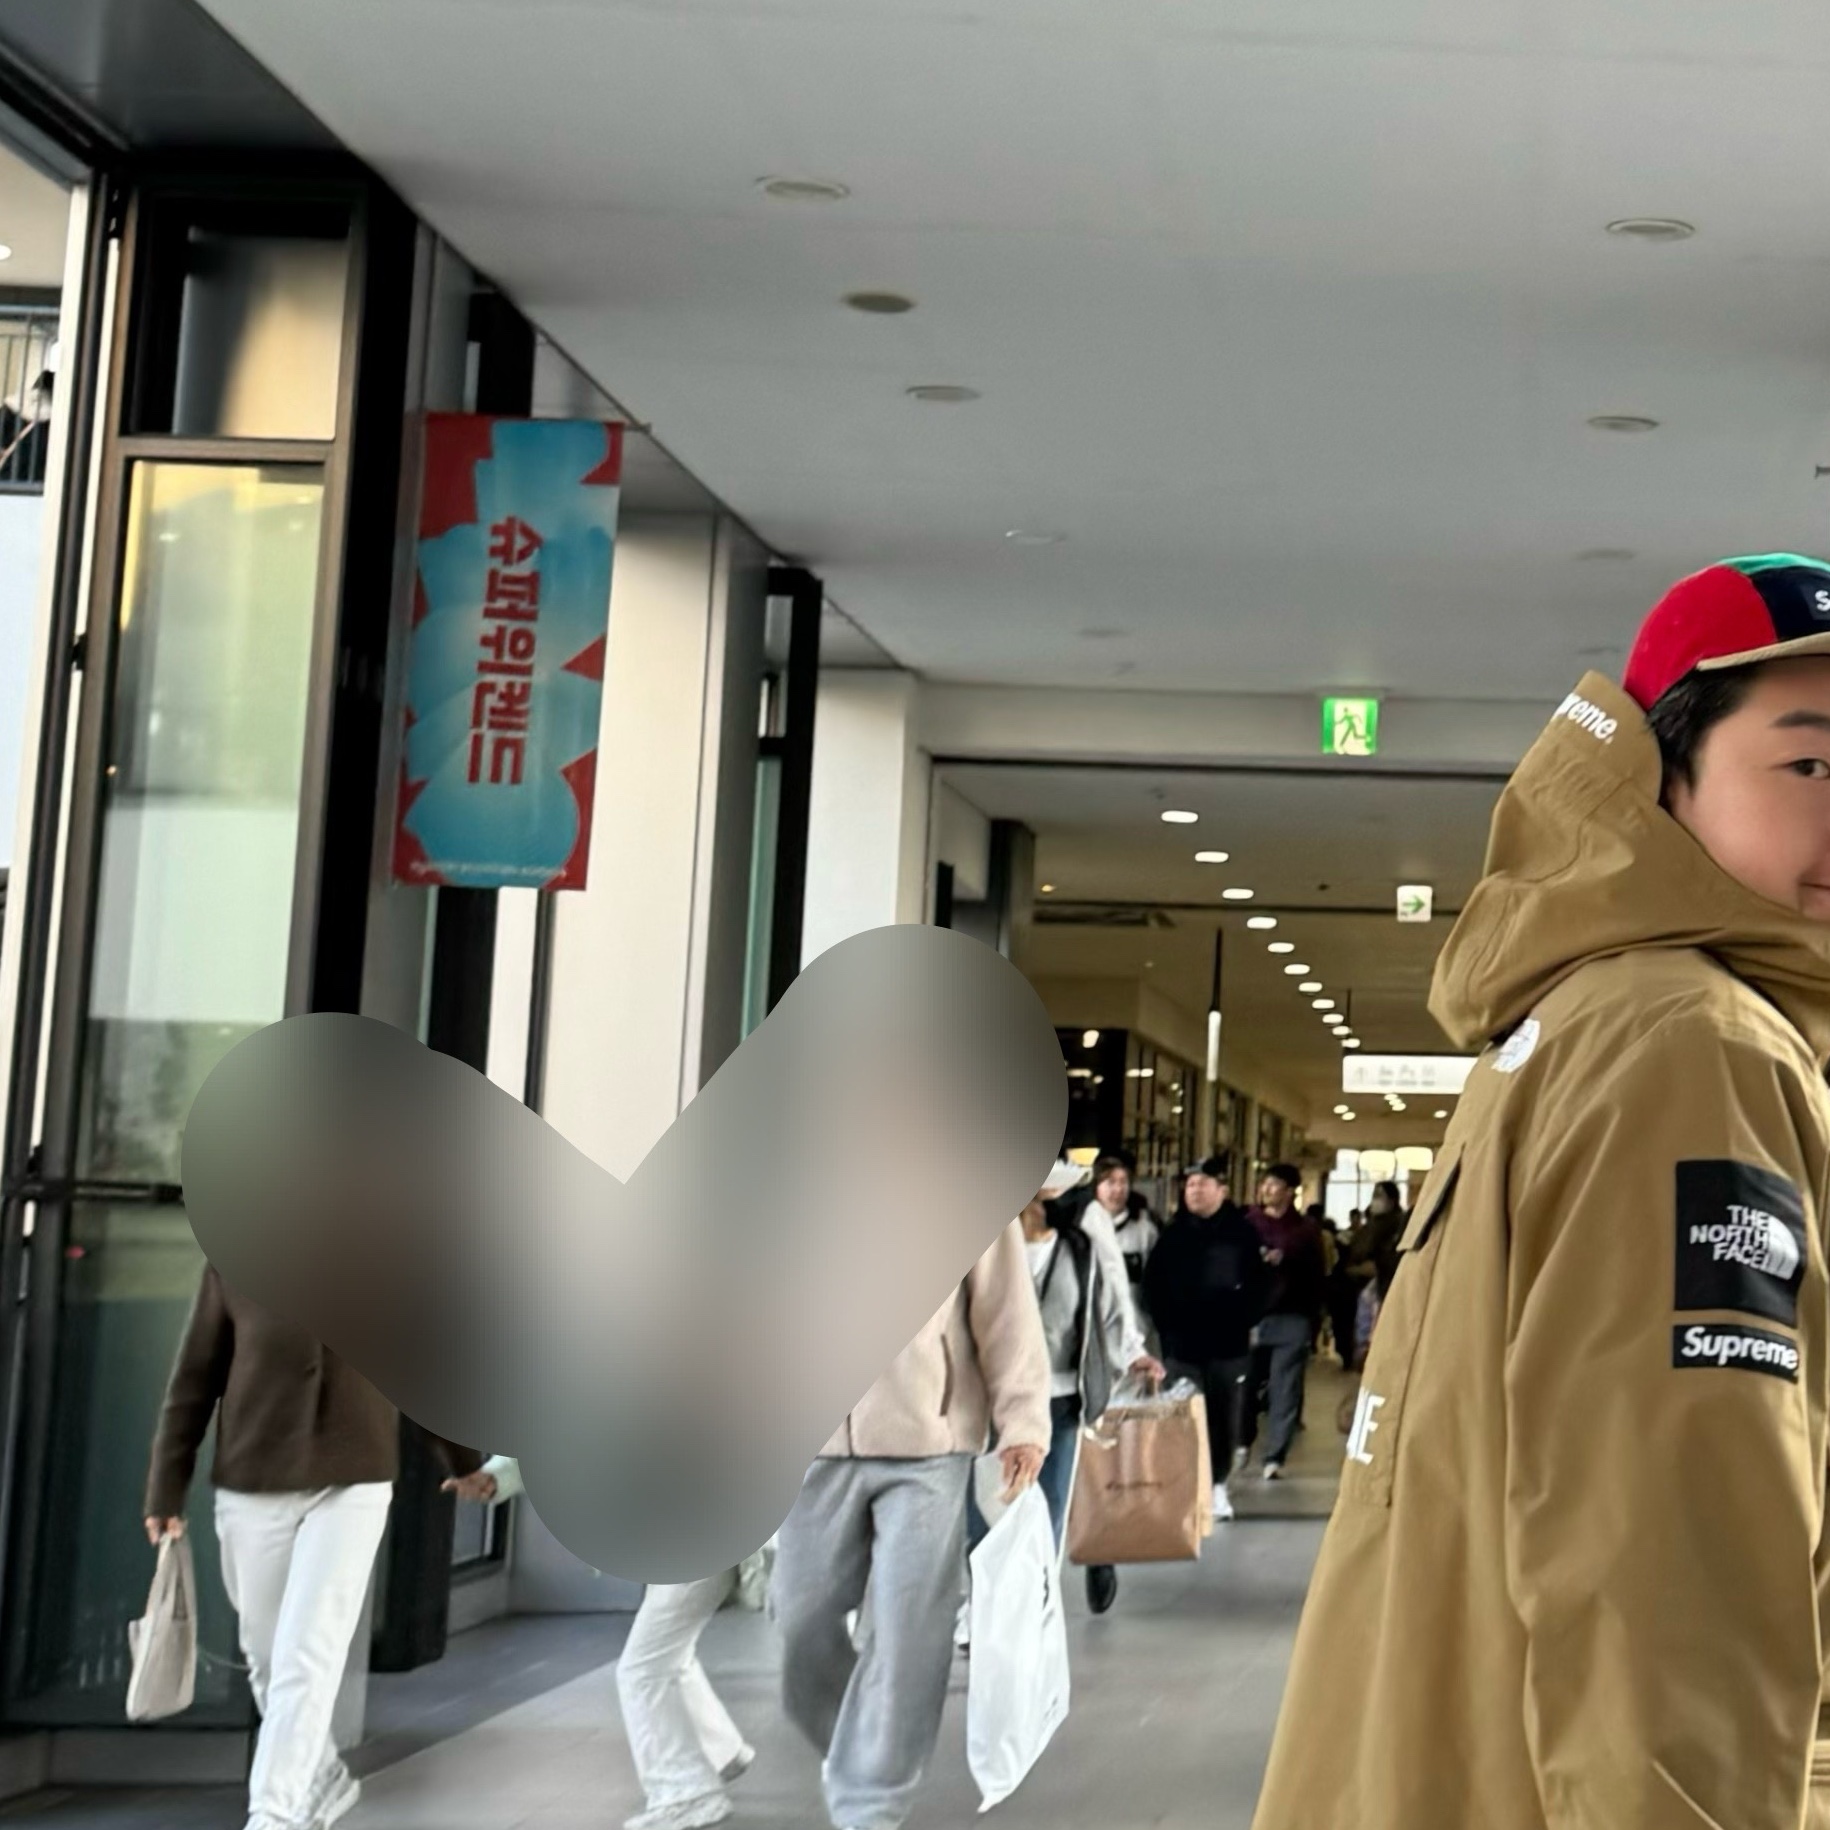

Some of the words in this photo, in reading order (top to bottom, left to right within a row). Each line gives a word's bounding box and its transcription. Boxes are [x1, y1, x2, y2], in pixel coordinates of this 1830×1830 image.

[467, 515, 543, 785] 슈퍼위켄드
[1549, 692, 1618, 745] reme
[1726, 1204, 1770, 1231] THE
[1689, 1223, 1770, 1251] NORTH
[1713, 1241, 1766, 1269] FACE
[1681, 1326, 1798, 1370] Supreme
